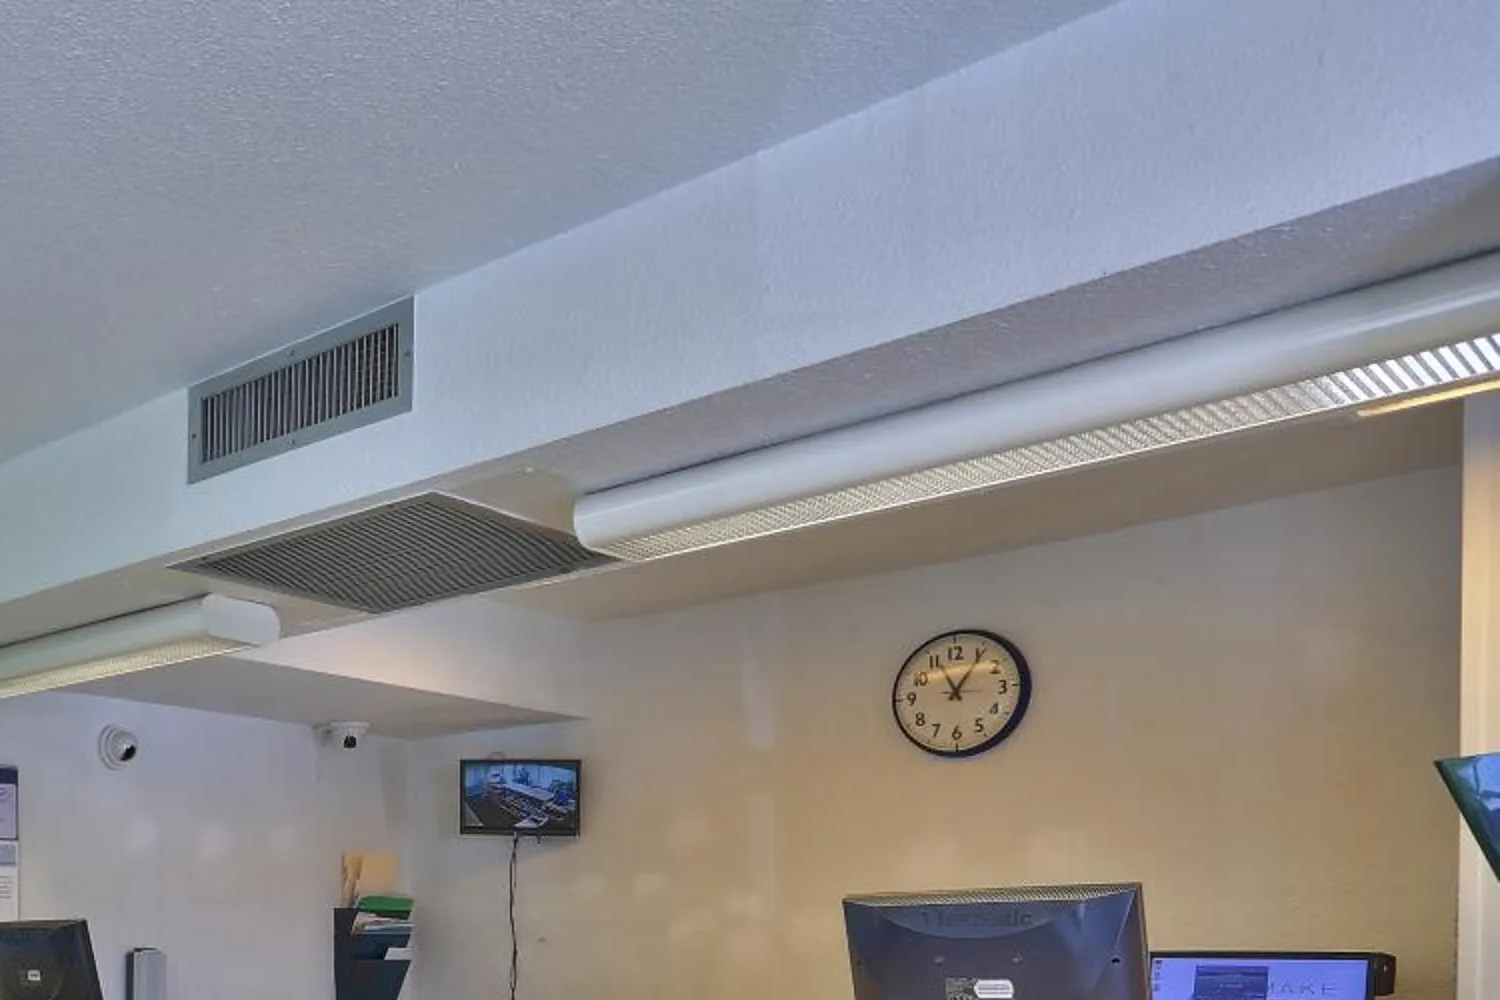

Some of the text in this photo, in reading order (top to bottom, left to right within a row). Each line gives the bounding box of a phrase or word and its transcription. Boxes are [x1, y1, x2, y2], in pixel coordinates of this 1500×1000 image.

[948, 646, 964, 661] 12
[929, 655, 939, 669] 11
[990, 660, 1001, 674] 2
[914, 672, 928, 687] 10
[998, 680, 1007, 694] 3
[907, 692, 916, 706] 9
[989, 703, 998, 714] 4
[915, 712, 926, 726] 8
[975, 718, 984, 733] 5
[932, 724, 941, 738] 7
[951, 726, 962, 740] 6
